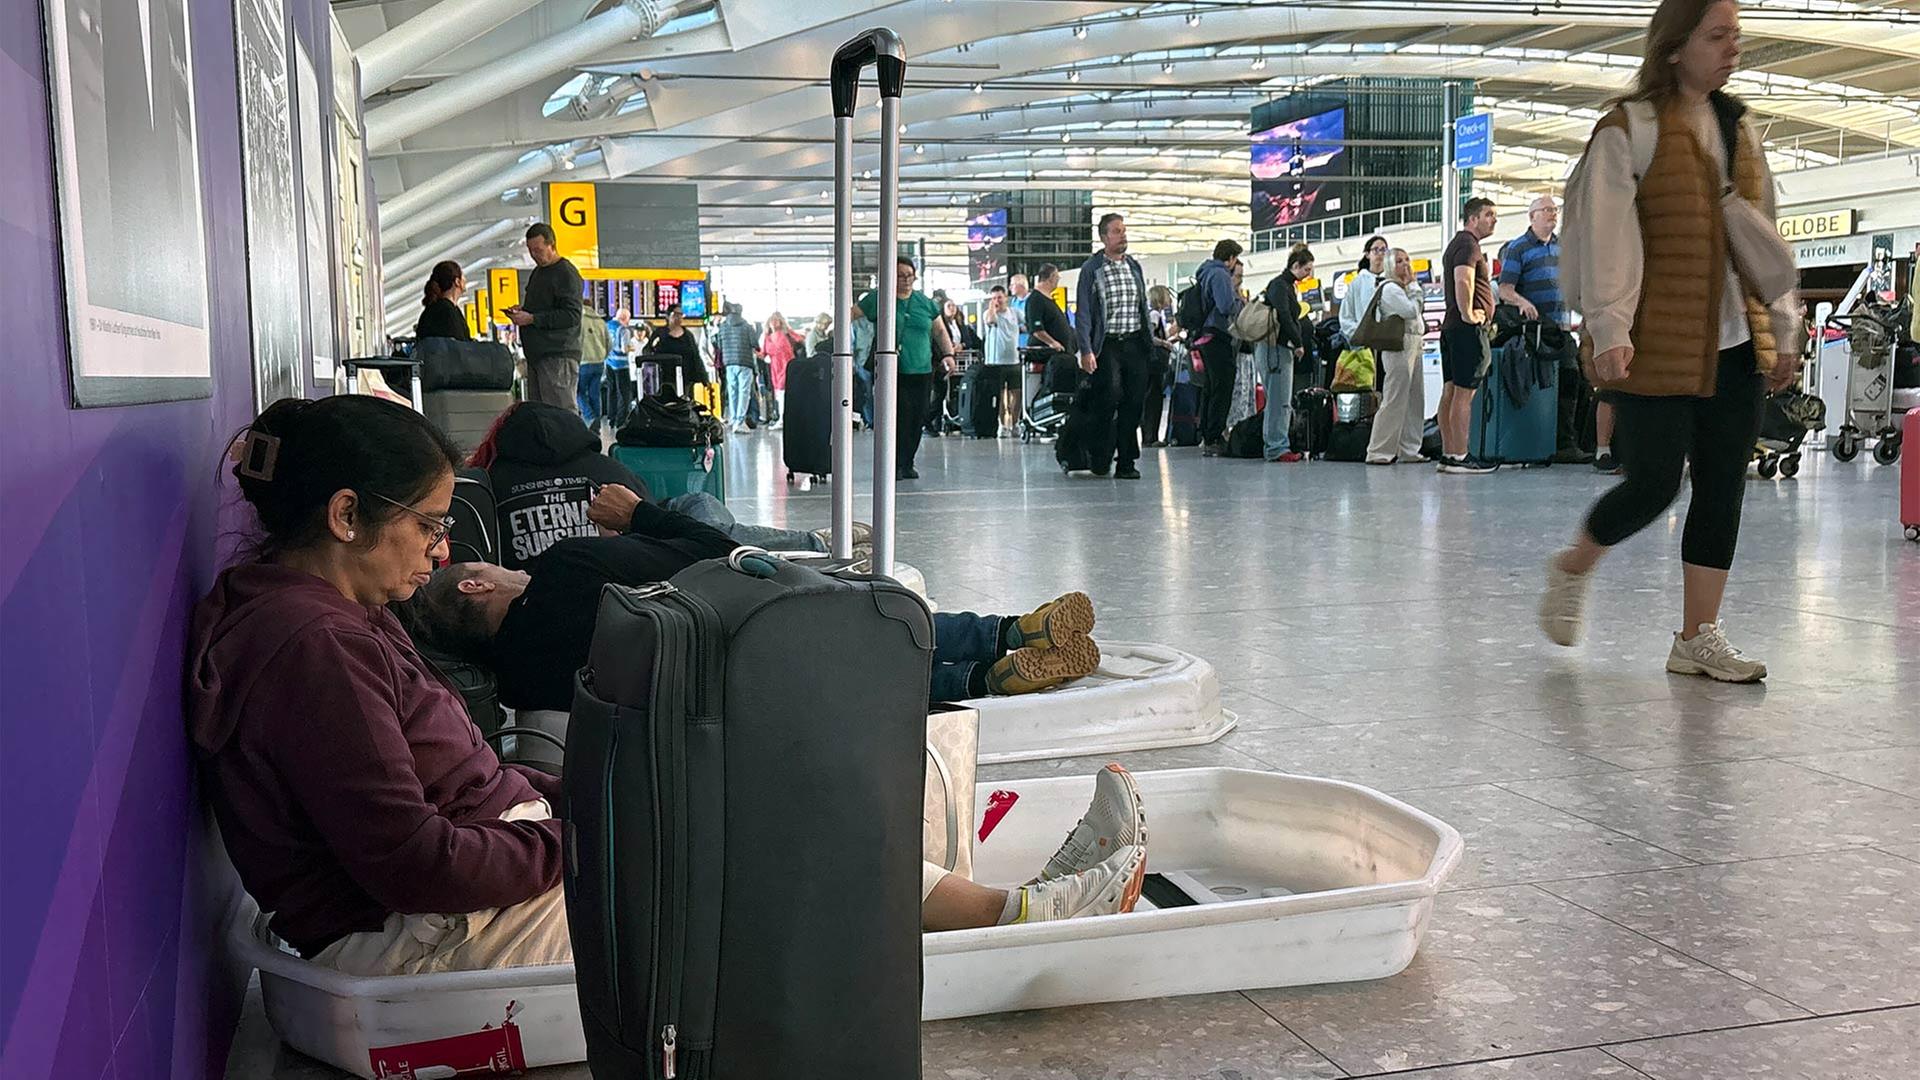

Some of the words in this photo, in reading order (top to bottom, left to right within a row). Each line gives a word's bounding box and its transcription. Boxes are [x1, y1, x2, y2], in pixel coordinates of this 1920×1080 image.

[559, 196, 586, 226] G
[1779, 215, 1840, 238] GLOBE
[1799, 244, 1846, 259] KITCHEN
[499, 276, 510, 294] F
[543, 492, 567, 504] THE
[510, 500, 594, 536] ETERNA
[1699, 648, 1712, 660] N
